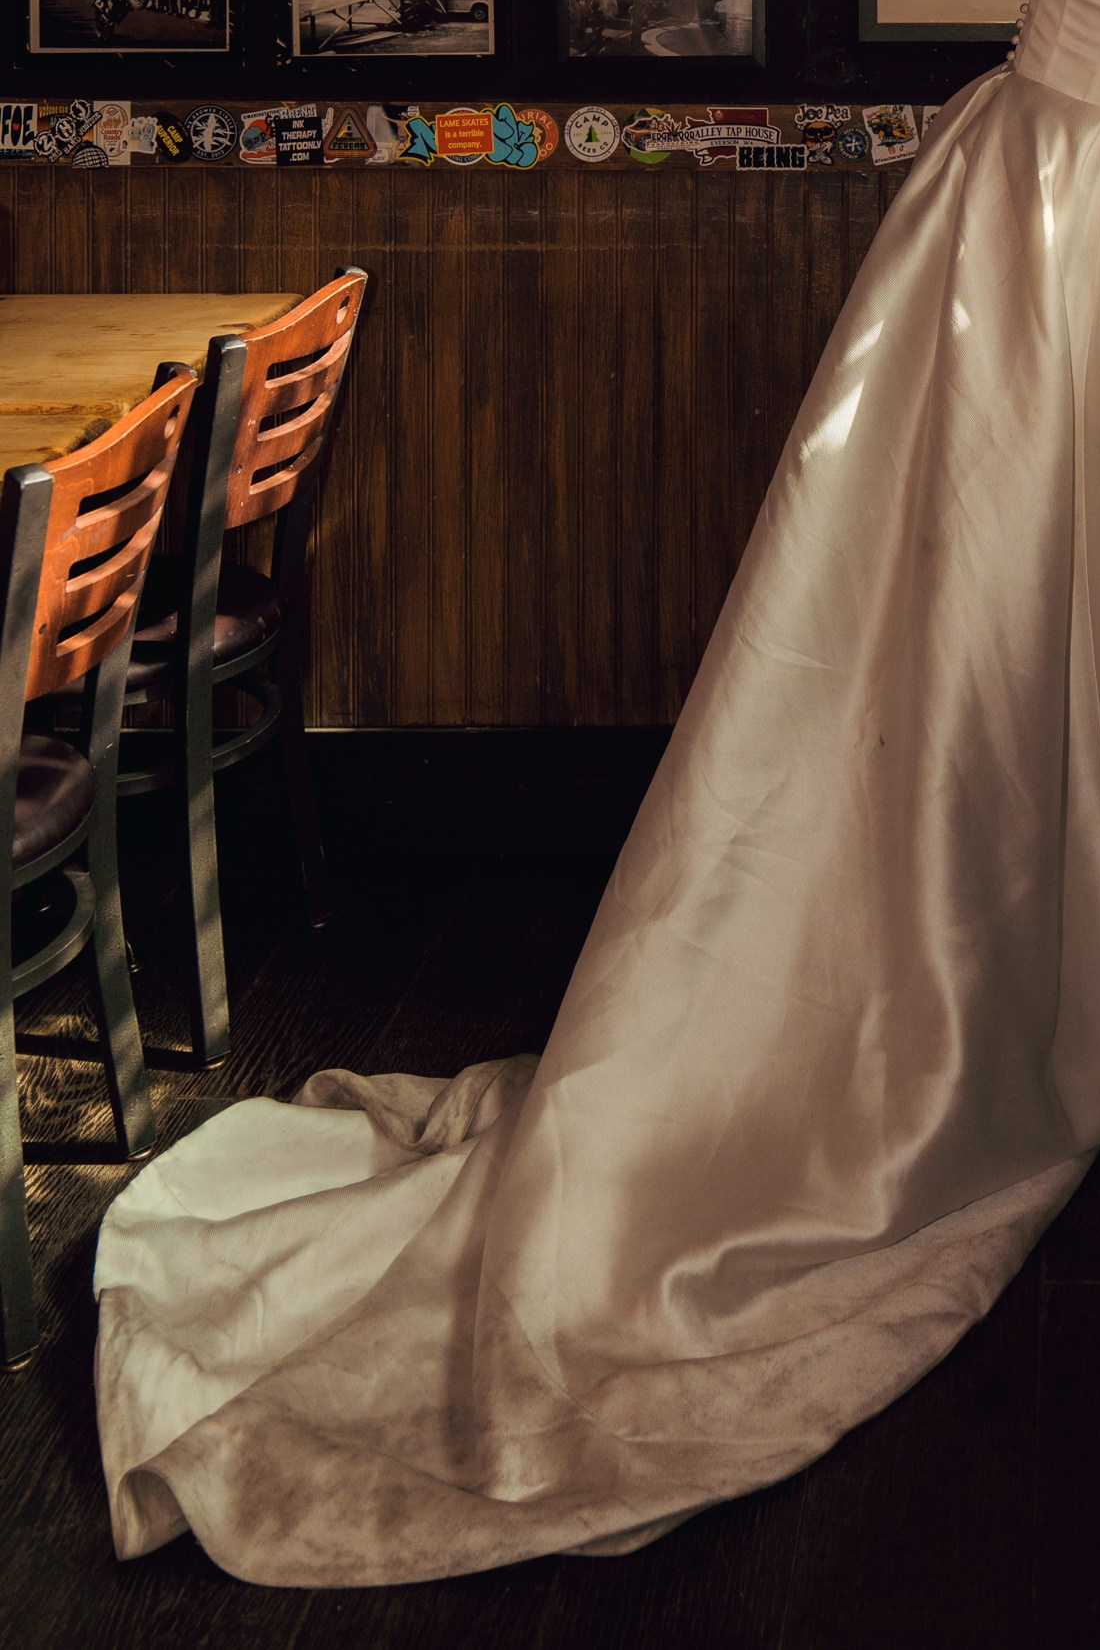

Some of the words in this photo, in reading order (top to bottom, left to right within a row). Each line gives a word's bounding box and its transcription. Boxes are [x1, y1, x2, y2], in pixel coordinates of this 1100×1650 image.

[797, 105, 823, 121] Joe
[292, 119, 305, 129] INK
[439, 119, 460, 127] LAME
[461, 118, 489, 127] SKATES
[574, 114, 610, 129] CAMP
[101, 129, 123, 137] Country
[167, 125, 184, 143] CAMP
[281, 129, 317, 140] THERAPY
[458, 129, 484, 138] terrible
[724, 126, 743, 138] TAP
[745, 127, 774, 140] HOUSE
[448, 142, 483, 150] company.
[577, 143, 597, 153] BEER
[290, 152, 310, 162] .COM
[738, 145, 806, 169] BEING
